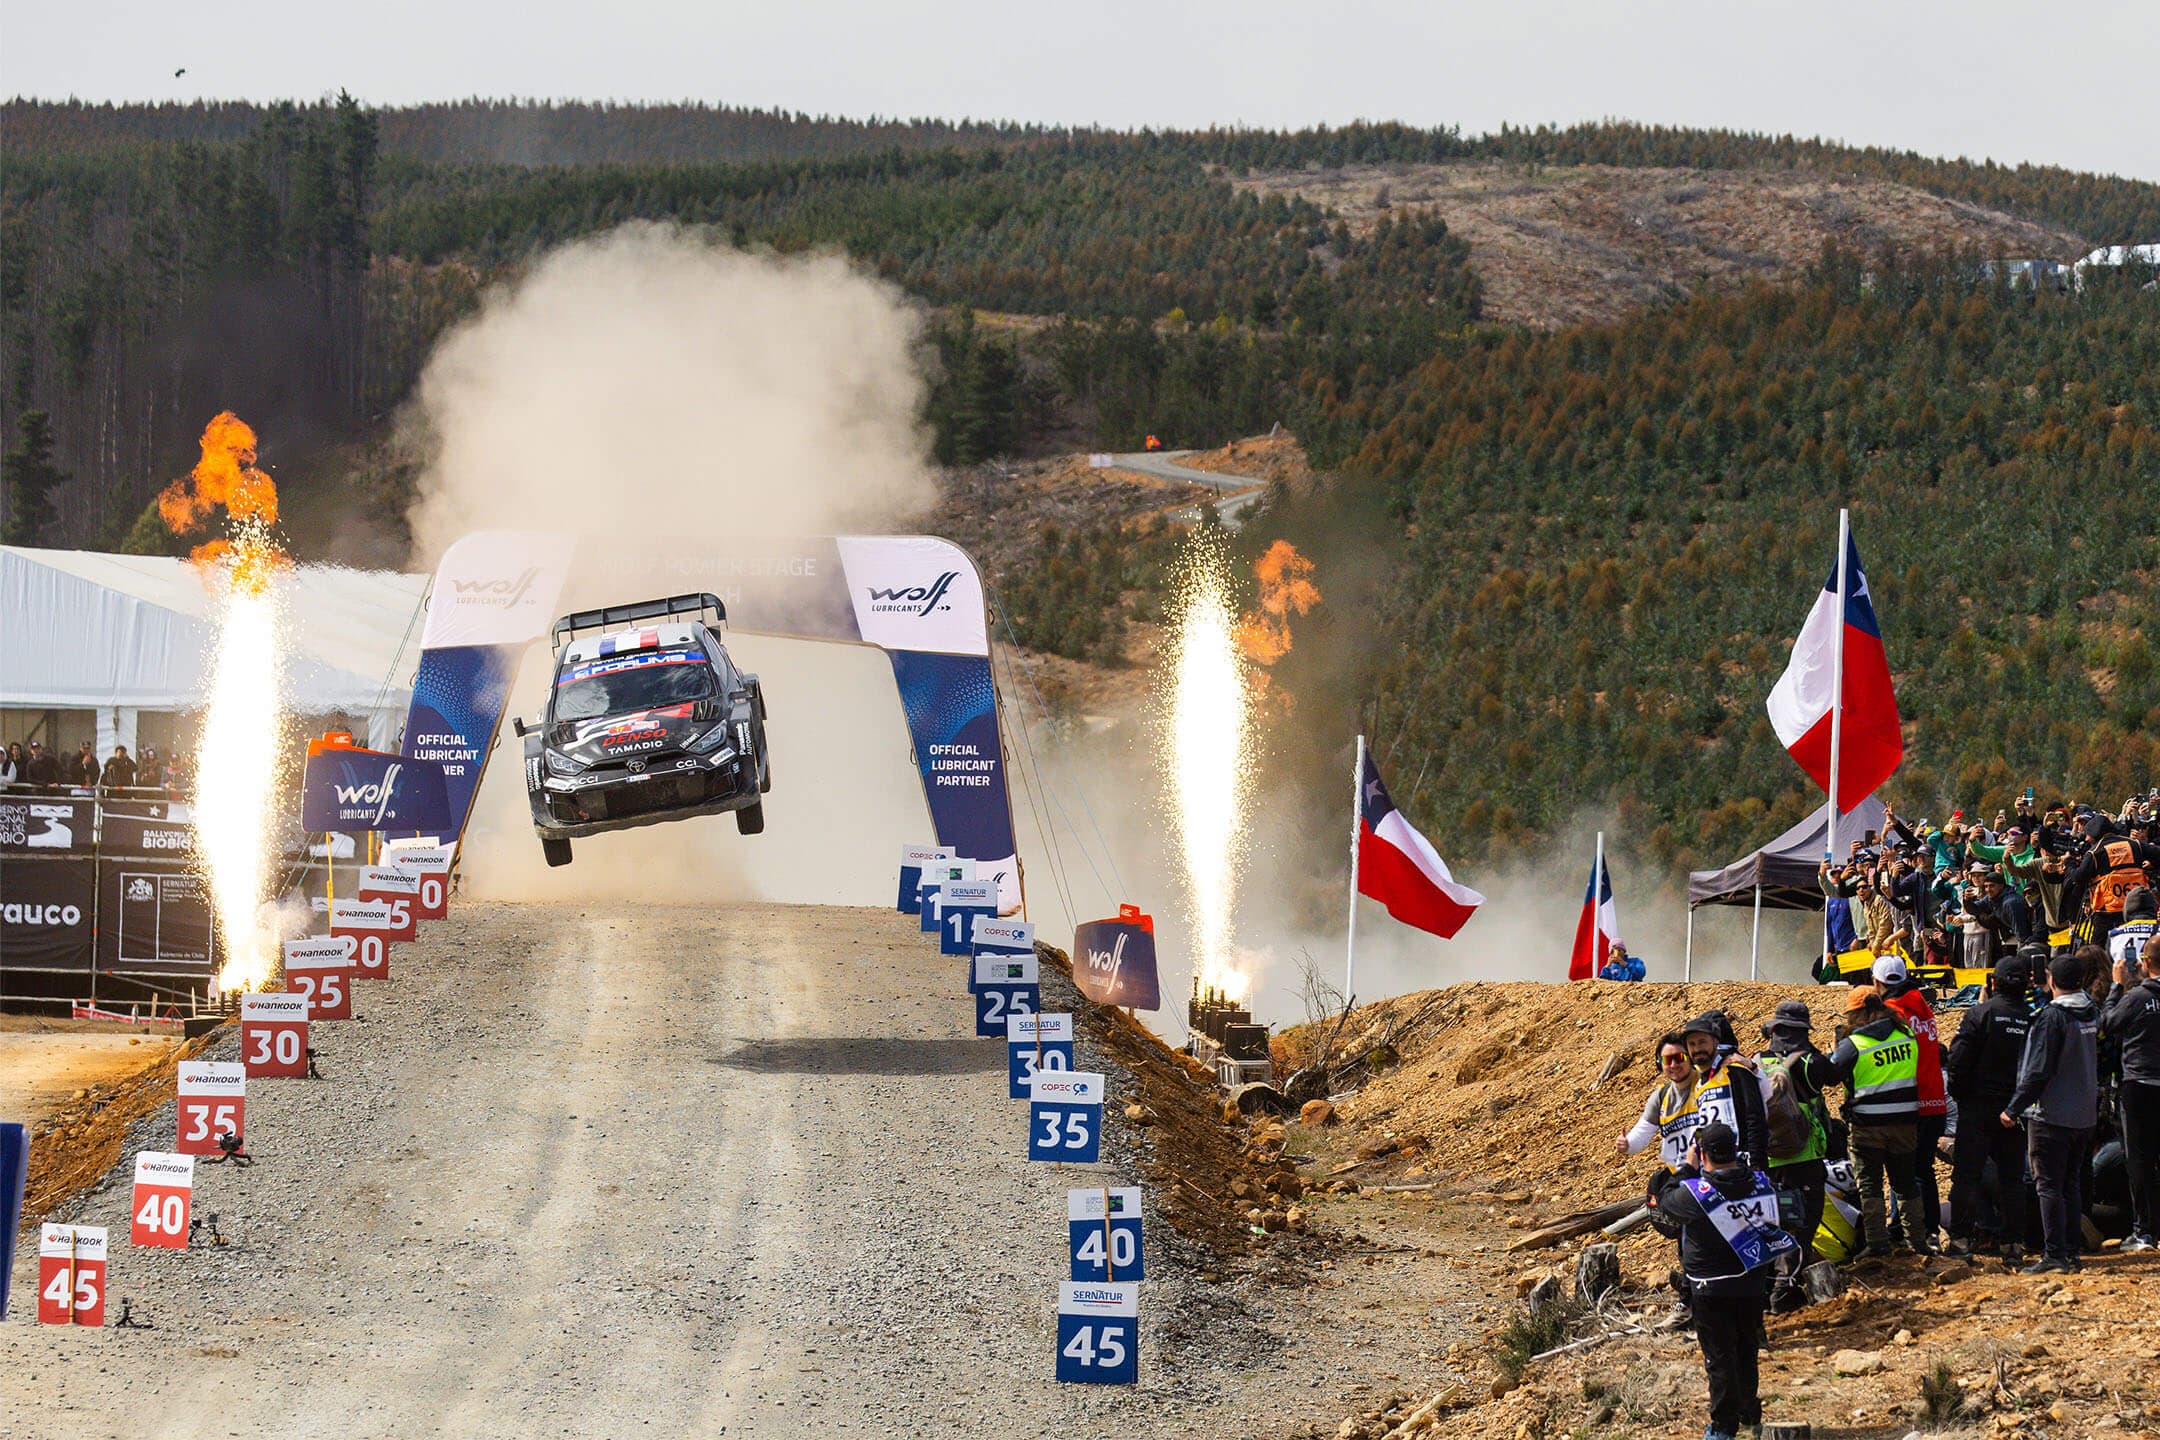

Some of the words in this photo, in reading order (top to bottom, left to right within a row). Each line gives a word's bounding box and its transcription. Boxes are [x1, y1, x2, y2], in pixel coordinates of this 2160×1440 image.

[750, 558, 817, 576] STAGE
[872, 604, 922, 613] LUBRICANTS
[417, 734, 468, 746] OFFICIAL
[602, 728, 668, 748] DENSO
[607, 740, 664, 755] TAMADIC
[414, 749, 479, 761] LUBRICANT
[929, 744, 980, 755] OFFICIAL
[676, 759, 697, 768] CCI
[932, 760, 996, 771] LUBRICANT
[578, 775, 599, 785] CCI
[936, 775, 991, 786] PARTNER
[0, 814, 26, 825] ONAL
[339, 808, 376, 820] LUBRICANTS
[422, 879, 442, 909] 0
[951, 888, 987, 896] SERNATUR
[2112, 882, 2141, 898] 06
[391, 899, 411, 930] 5
[927, 891, 941, 920] 1
[294, 975, 343, 1009] 25
[983, 991, 1031, 1024] 25
[249, 1029, 300, 1065] 30
[1873, 1043, 1912, 1067] STAFF
[1017, 1049, 1066, 1085] 30
[185, 1104, 237, 1141] 35
[1037, 1111, 1089, 1149] 35
[136, 1194, 184, 1235] 40
[1727, 1201, 1764, 1220] 804
[1076, 1228, 1135, 1267] 40
[43, 1268, 98, 1310] 45
[1073, 1290, 1123, 1301] SERNATUR
[1063, 1325, 1126, 1368] 45
